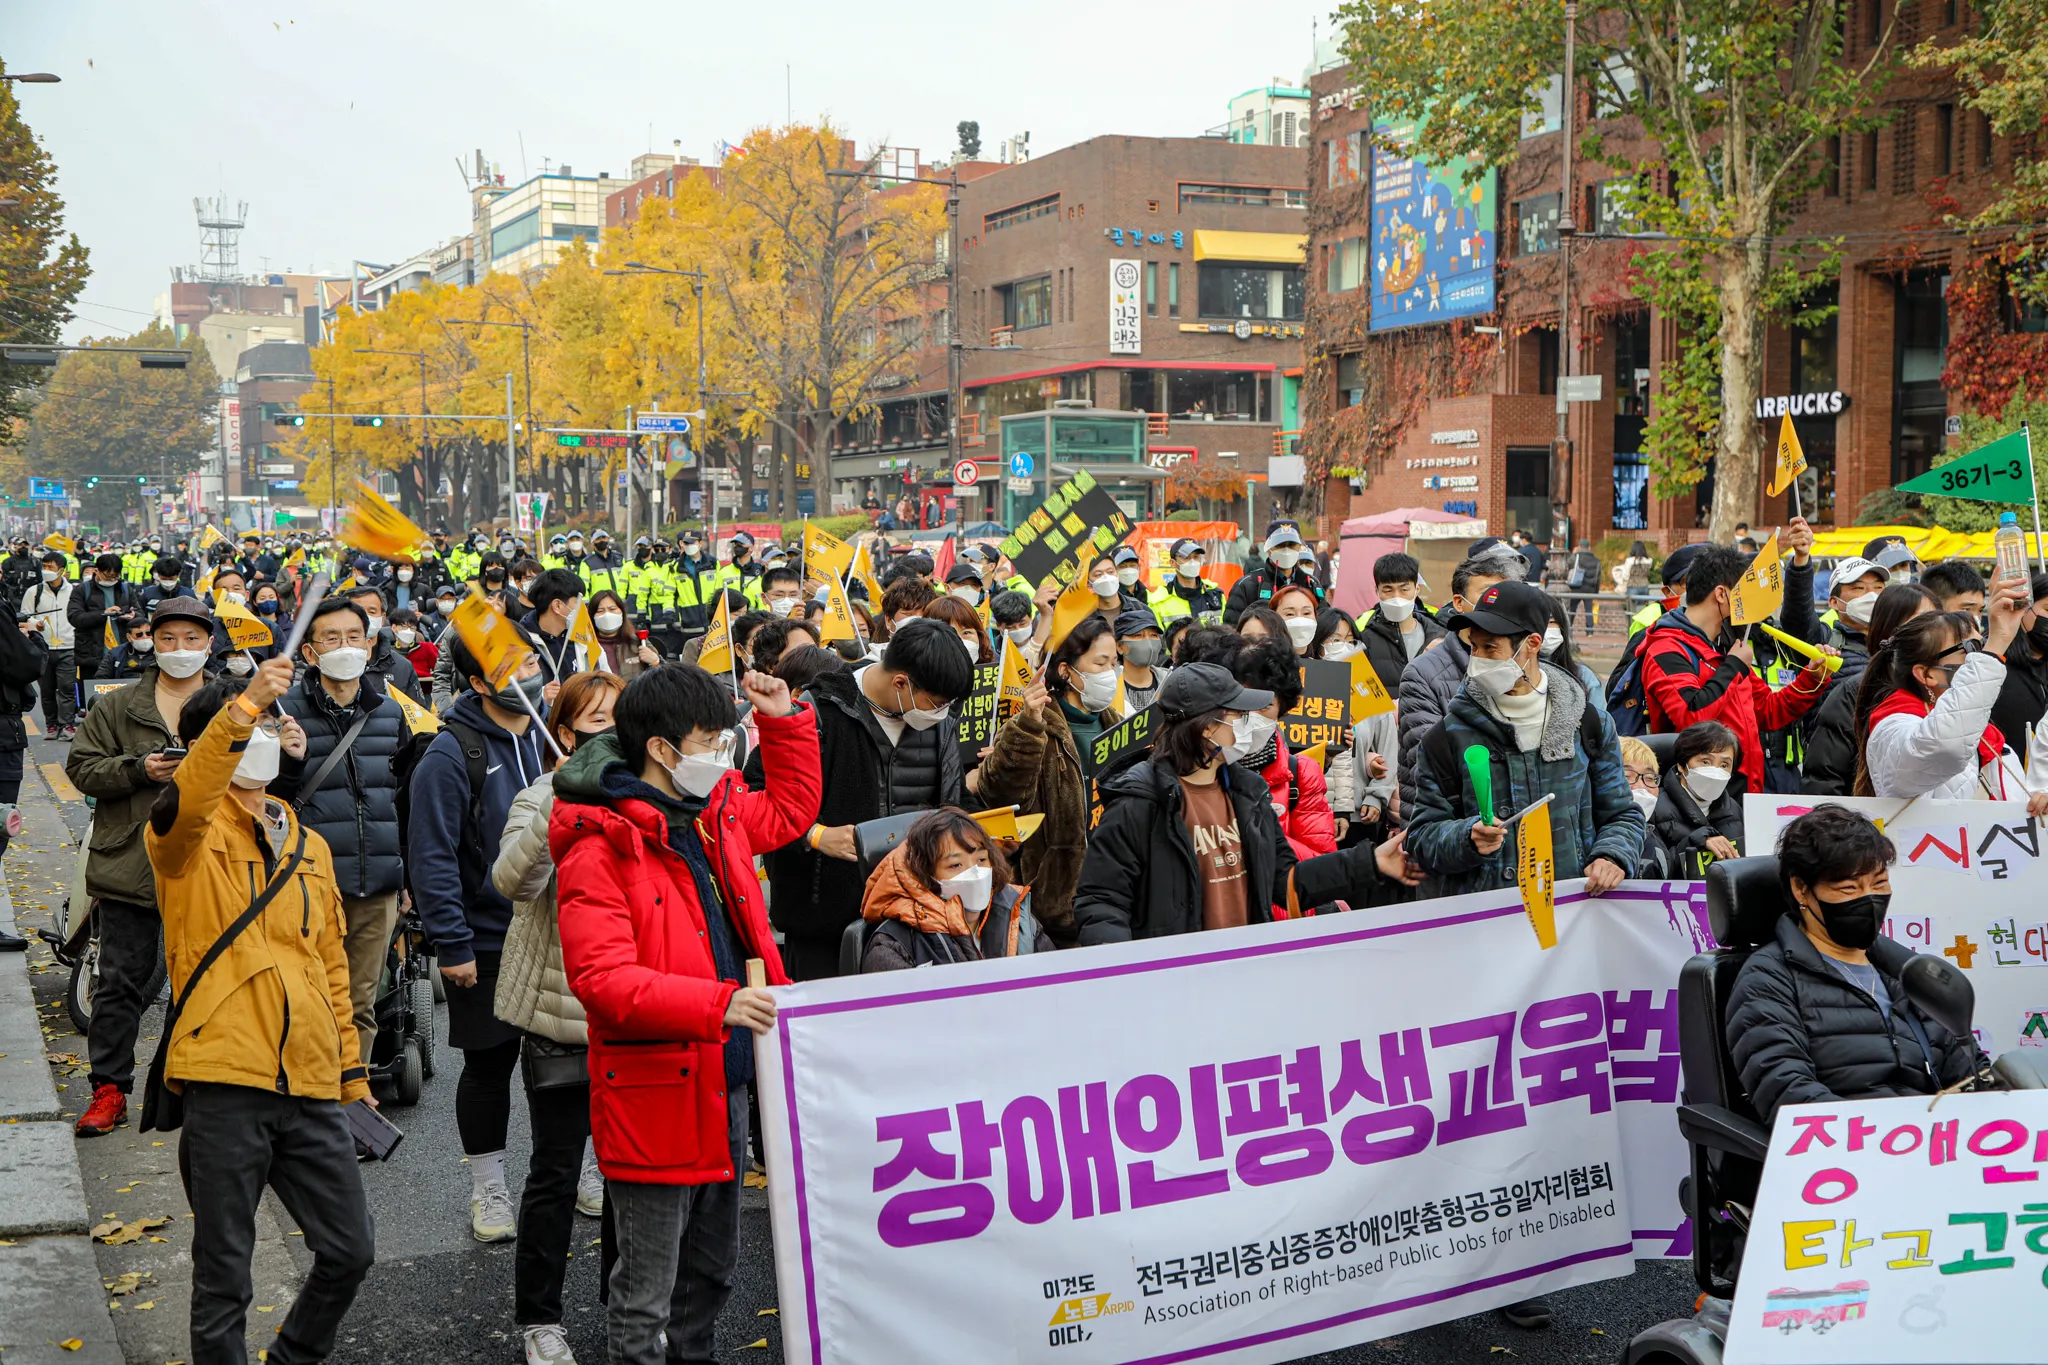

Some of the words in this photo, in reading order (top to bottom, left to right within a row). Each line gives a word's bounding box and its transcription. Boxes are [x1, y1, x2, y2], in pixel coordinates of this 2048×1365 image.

[1115, 306, 1139, 327] 김군
[1114, 329, 1140, 350] 맥주
[1756, 390, 1844, 420] RBUCKS
[1151, 452, 1189, 468] KFC
[1941, 460, 2023, 491] 36기-3
[1769, 562, 1780, 593] 이것도
[832, 597, 846, 621] 이것도
[249, 631, 269, 643] PRIDE
[1094, 710, 1150, 764] 장애인
[873, 989, 1681, 1248] 장애인평생교육법
[1786, 1114, 2048, 1205] 장애인
[1136, 1161, 1615, 1298] 전국권리중심중증장애인맞춤형공공일자리협회
[1782, 1218, 1934, 1271] 타고
[1143, 1289, 1252, 1325] Association
[1258, 1279, 1277, 1301] of
[1283, 1254, 1384, 1298] Right-based
[1389, 1238, 1442, 1268] Public
[1448, 1232, 1487, 1257] Jobs
[1491, 1226, 1514, 1247] for
[1518, 1218, 1545, 1240] the
[1548, 1198, 1616, 1231] Disabled
[1043, 1273, 1096, 1300] 이것도
[1063, 1296, 1099, 1322] 노동
[1102, 1300, 1135, 1317] ARPJD
